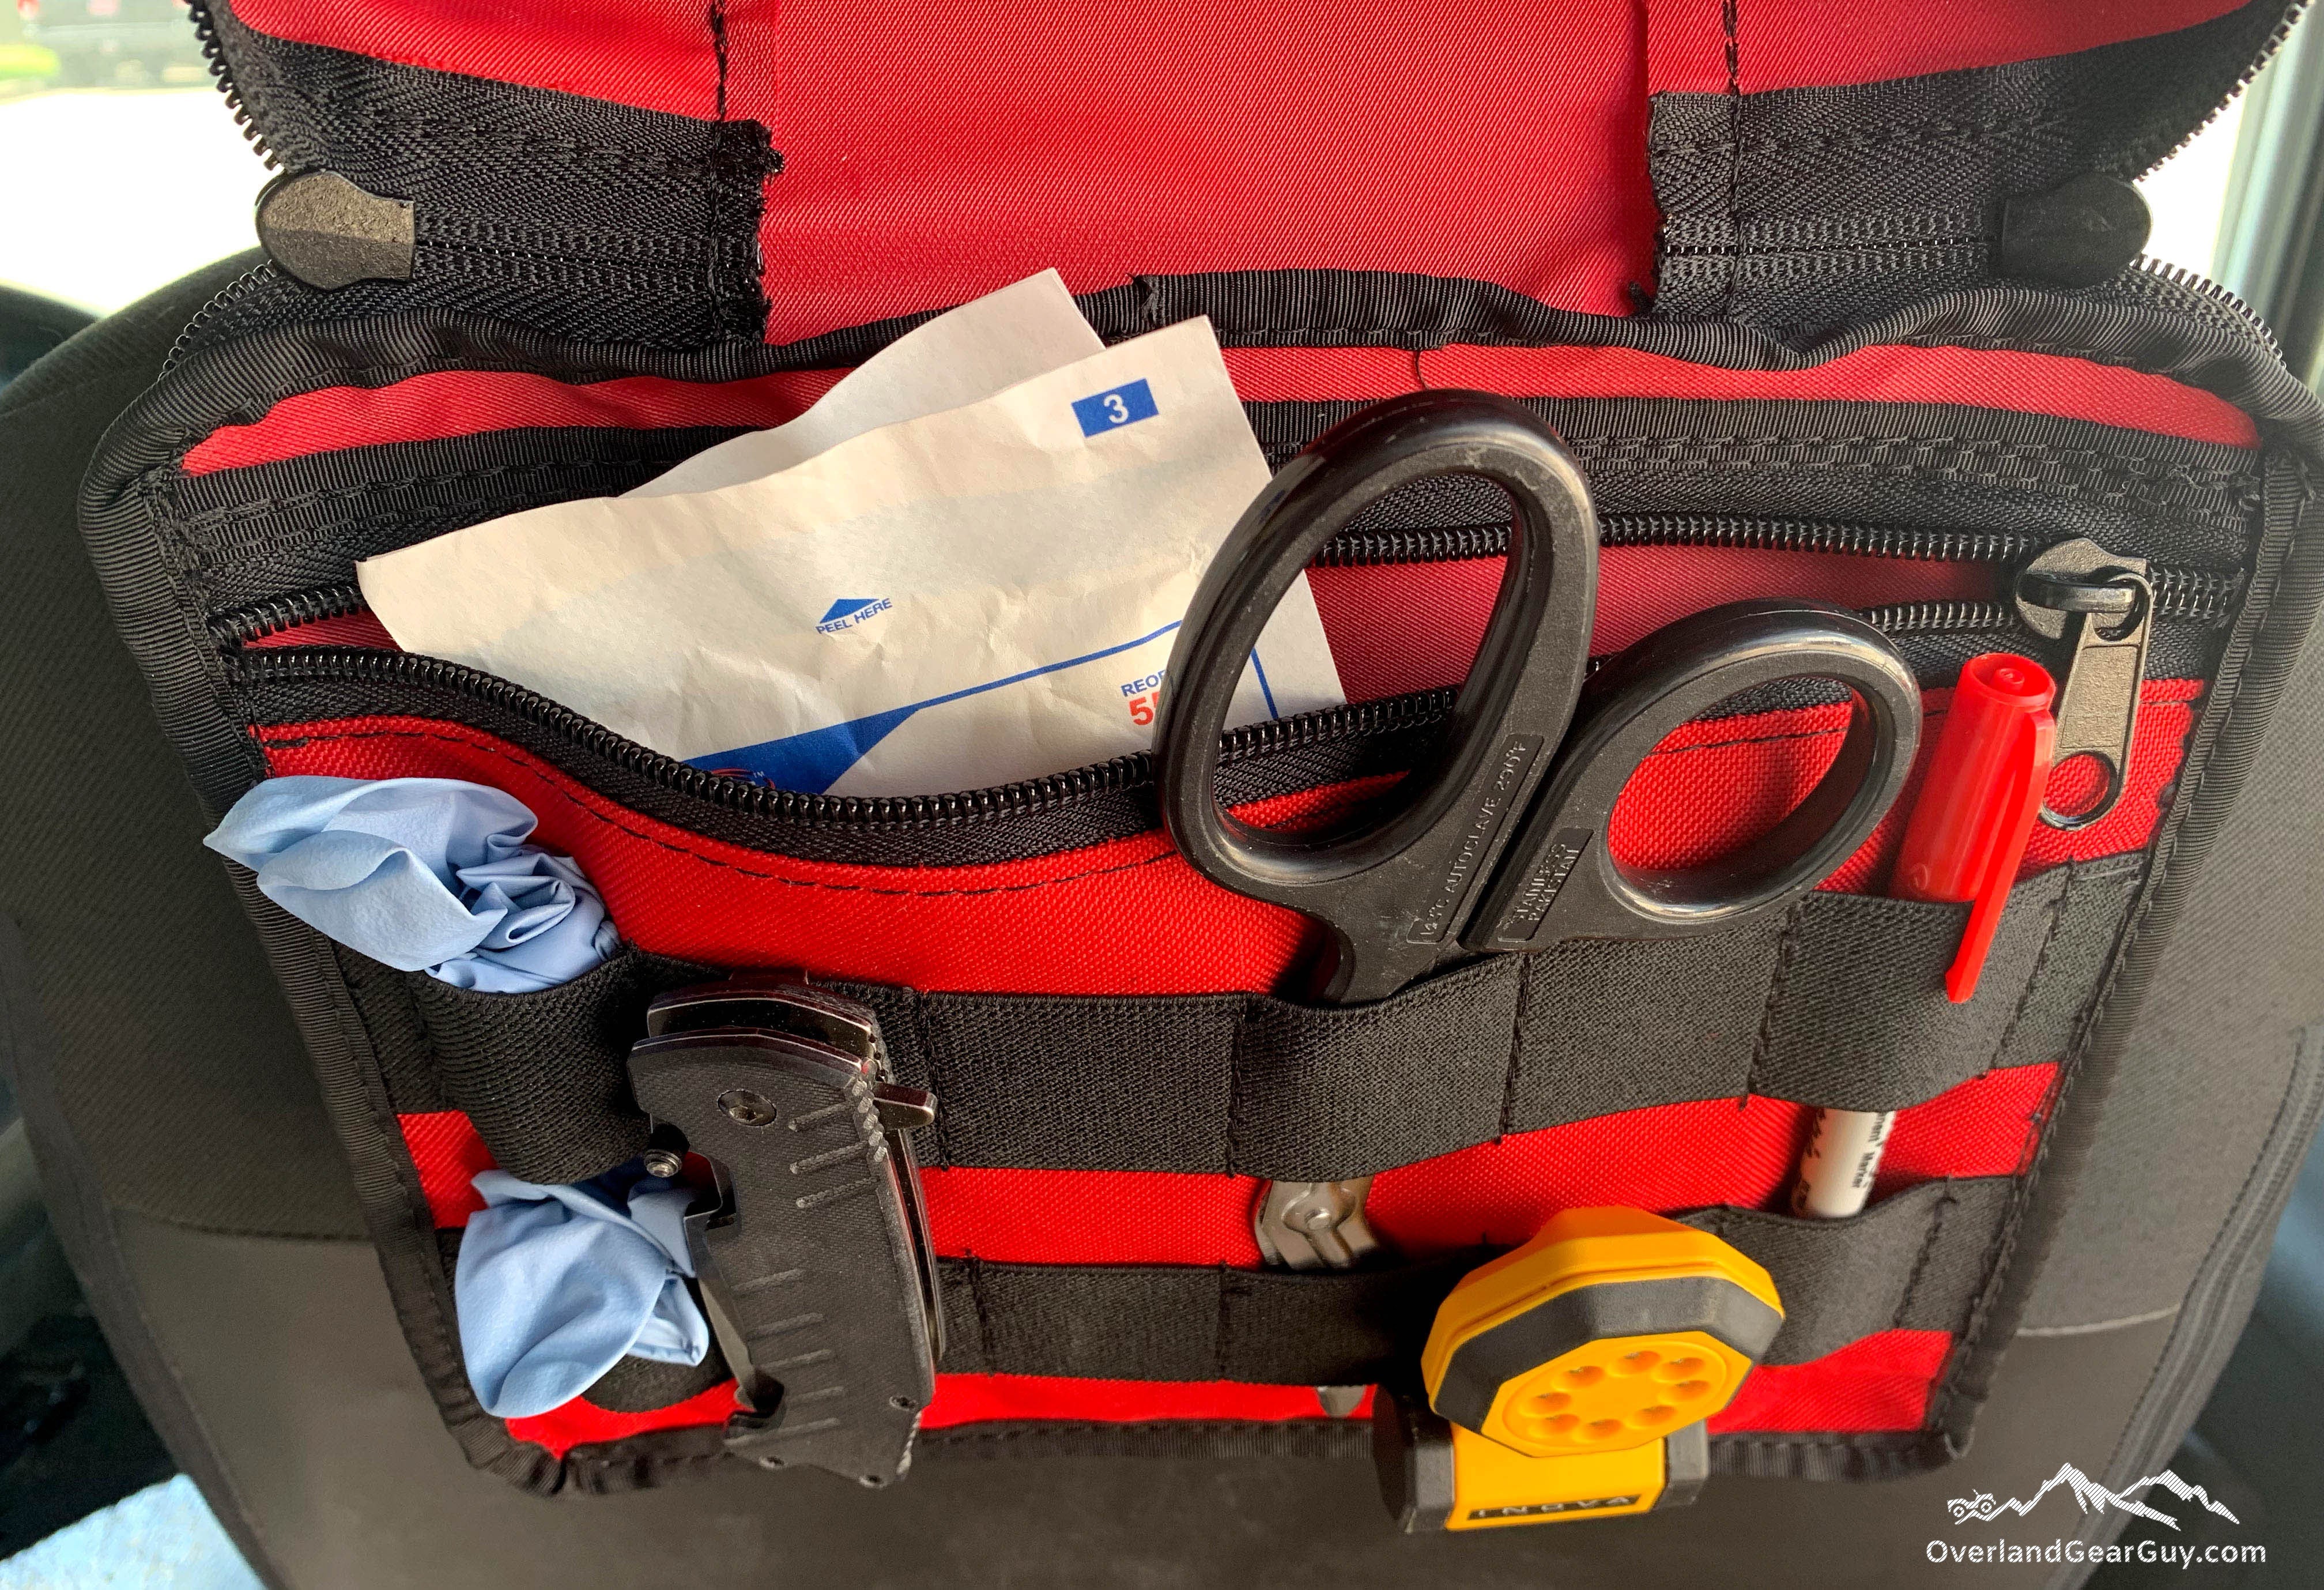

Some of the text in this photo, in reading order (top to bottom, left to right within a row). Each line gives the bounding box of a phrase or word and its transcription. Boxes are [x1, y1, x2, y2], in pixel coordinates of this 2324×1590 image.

[1103, 394, 1129, 424] 3
[815, 598, 893, 634] PEEL HERE
[1444, 797, 1501, 894] AUTOCLAVE
[1527, 849, 1579, 921] PAKISTAN
[1478, 1495, 1631, 1519] INOVA
